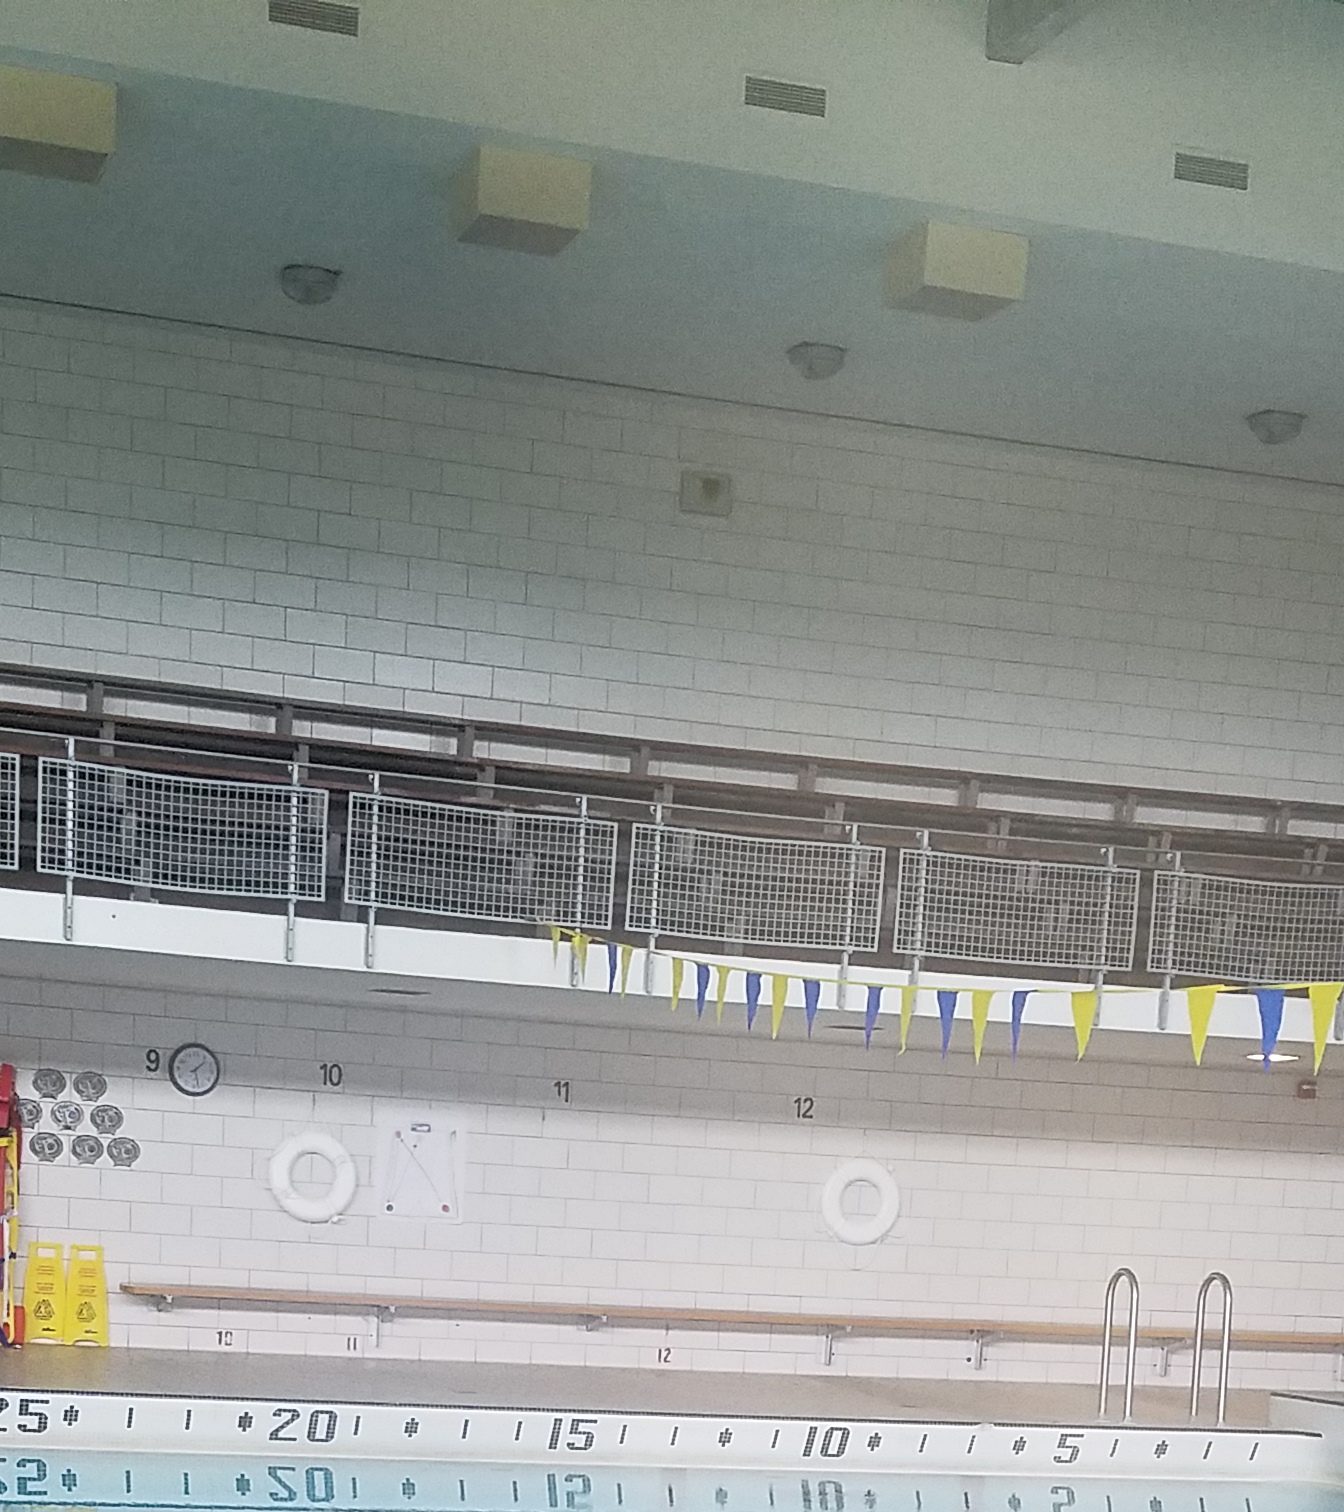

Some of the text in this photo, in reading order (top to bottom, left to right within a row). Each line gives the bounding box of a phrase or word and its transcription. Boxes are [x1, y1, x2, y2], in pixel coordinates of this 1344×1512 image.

[145, 1048, 160, 1073] 9
[319, 1062, 343, 1087] 10
[553, 1080, 570, 1103] 11
[793, 1096, 816, 1119] 12
[216, 1330, 234, 1347] 10
[658, 1346, 672, 1363] 12
[268, 1407, 339, 1443] 20
[547, 1417, 599, 1451] 15
[802, 1425, 850, 1458] 10
[1053, 1432, 1085, 1464] 5
